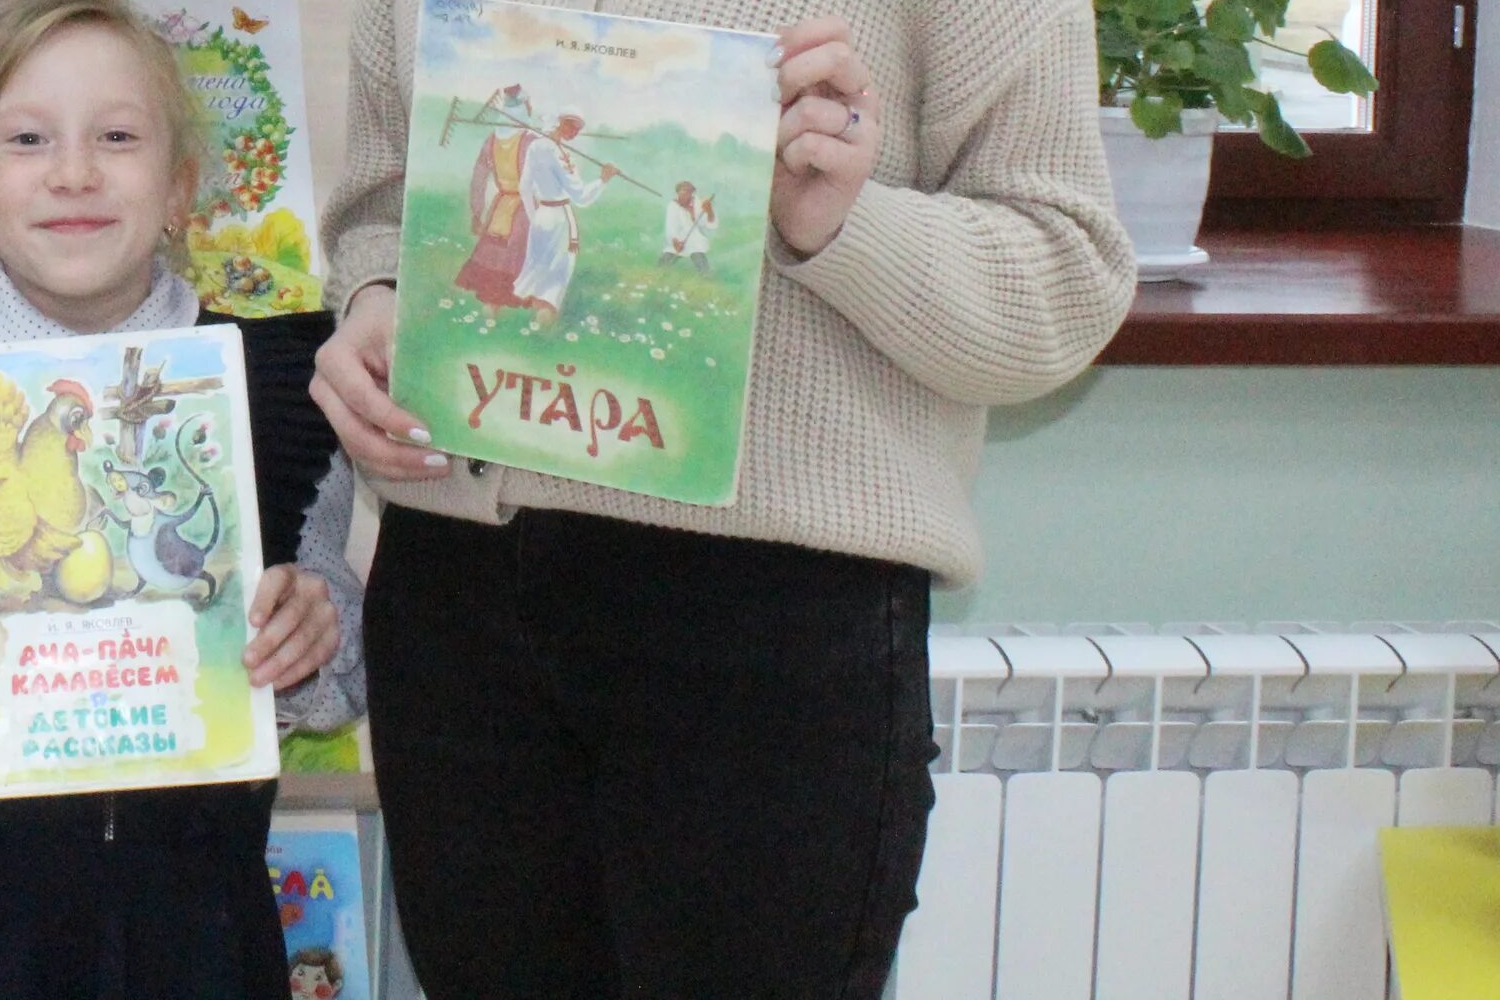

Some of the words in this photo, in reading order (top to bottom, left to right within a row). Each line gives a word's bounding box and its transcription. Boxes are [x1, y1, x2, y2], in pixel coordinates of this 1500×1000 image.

[583, 43, 638, 59] ЯКОВЛЕВ
[82, 616, 133, 629] ЯКОВЛЕВ
[28, 704, 167, 734] ДЕТСКИЕ
[21, 731, 177, 760] РАССКАЗЫ
